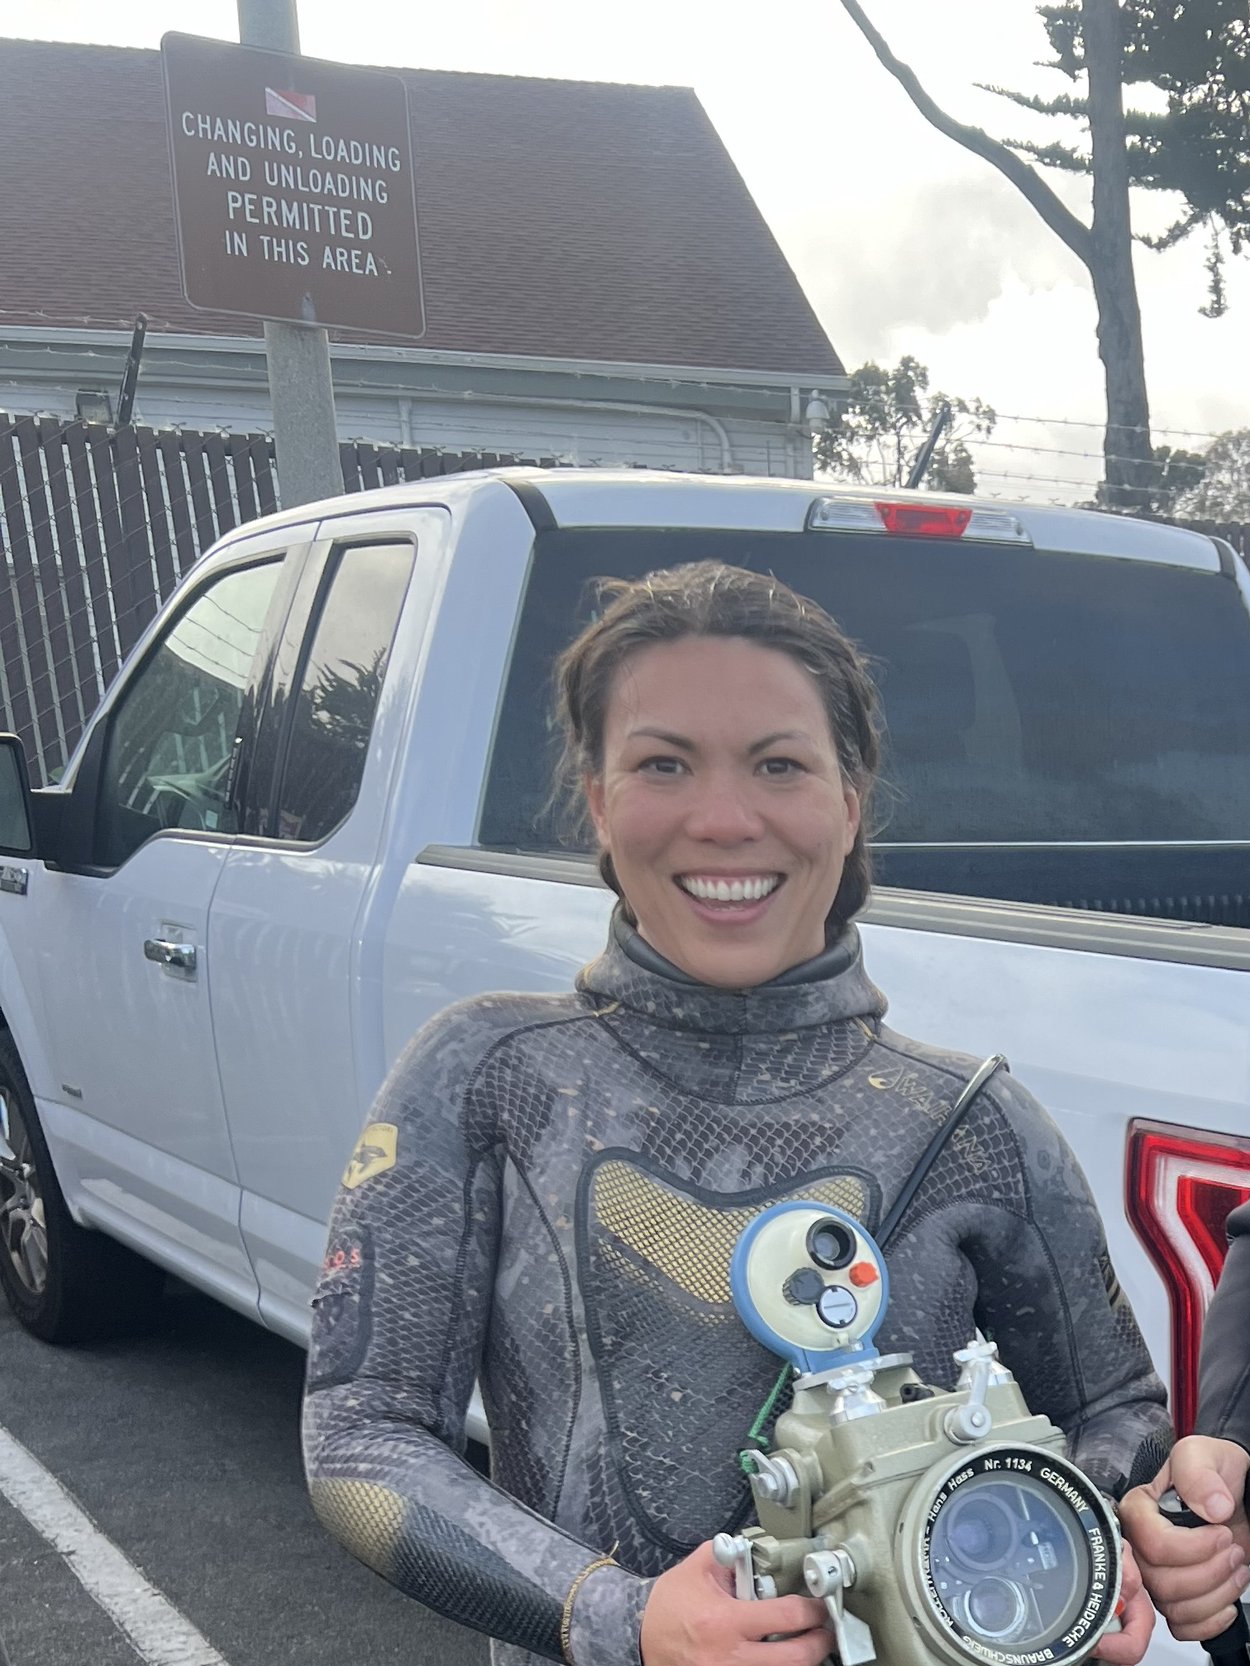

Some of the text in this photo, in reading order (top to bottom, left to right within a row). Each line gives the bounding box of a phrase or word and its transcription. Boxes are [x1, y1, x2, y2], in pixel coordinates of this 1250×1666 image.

[182, 111, 401, 172] CHANGING, LOADING
[207, 152, 389, 204] AND UNLOADING
[227, 191, 373, 240] PERMITTED
[224, 229, 248, 257] IN
[259, 235, 310, 266] THIS
[948, 1467, 975, 1491] Hass
[984, 1457, 1033, 1472] Nr. 1134
[1040, 1467, 1090, 1513] GERMANY
[1088, 1526, 1107, 1581] FRANKE
[1061, 1593, 1103, 1649] HEIDECKE
[962, 1635, 1055, 1665] BRAUNSCHWEIG
